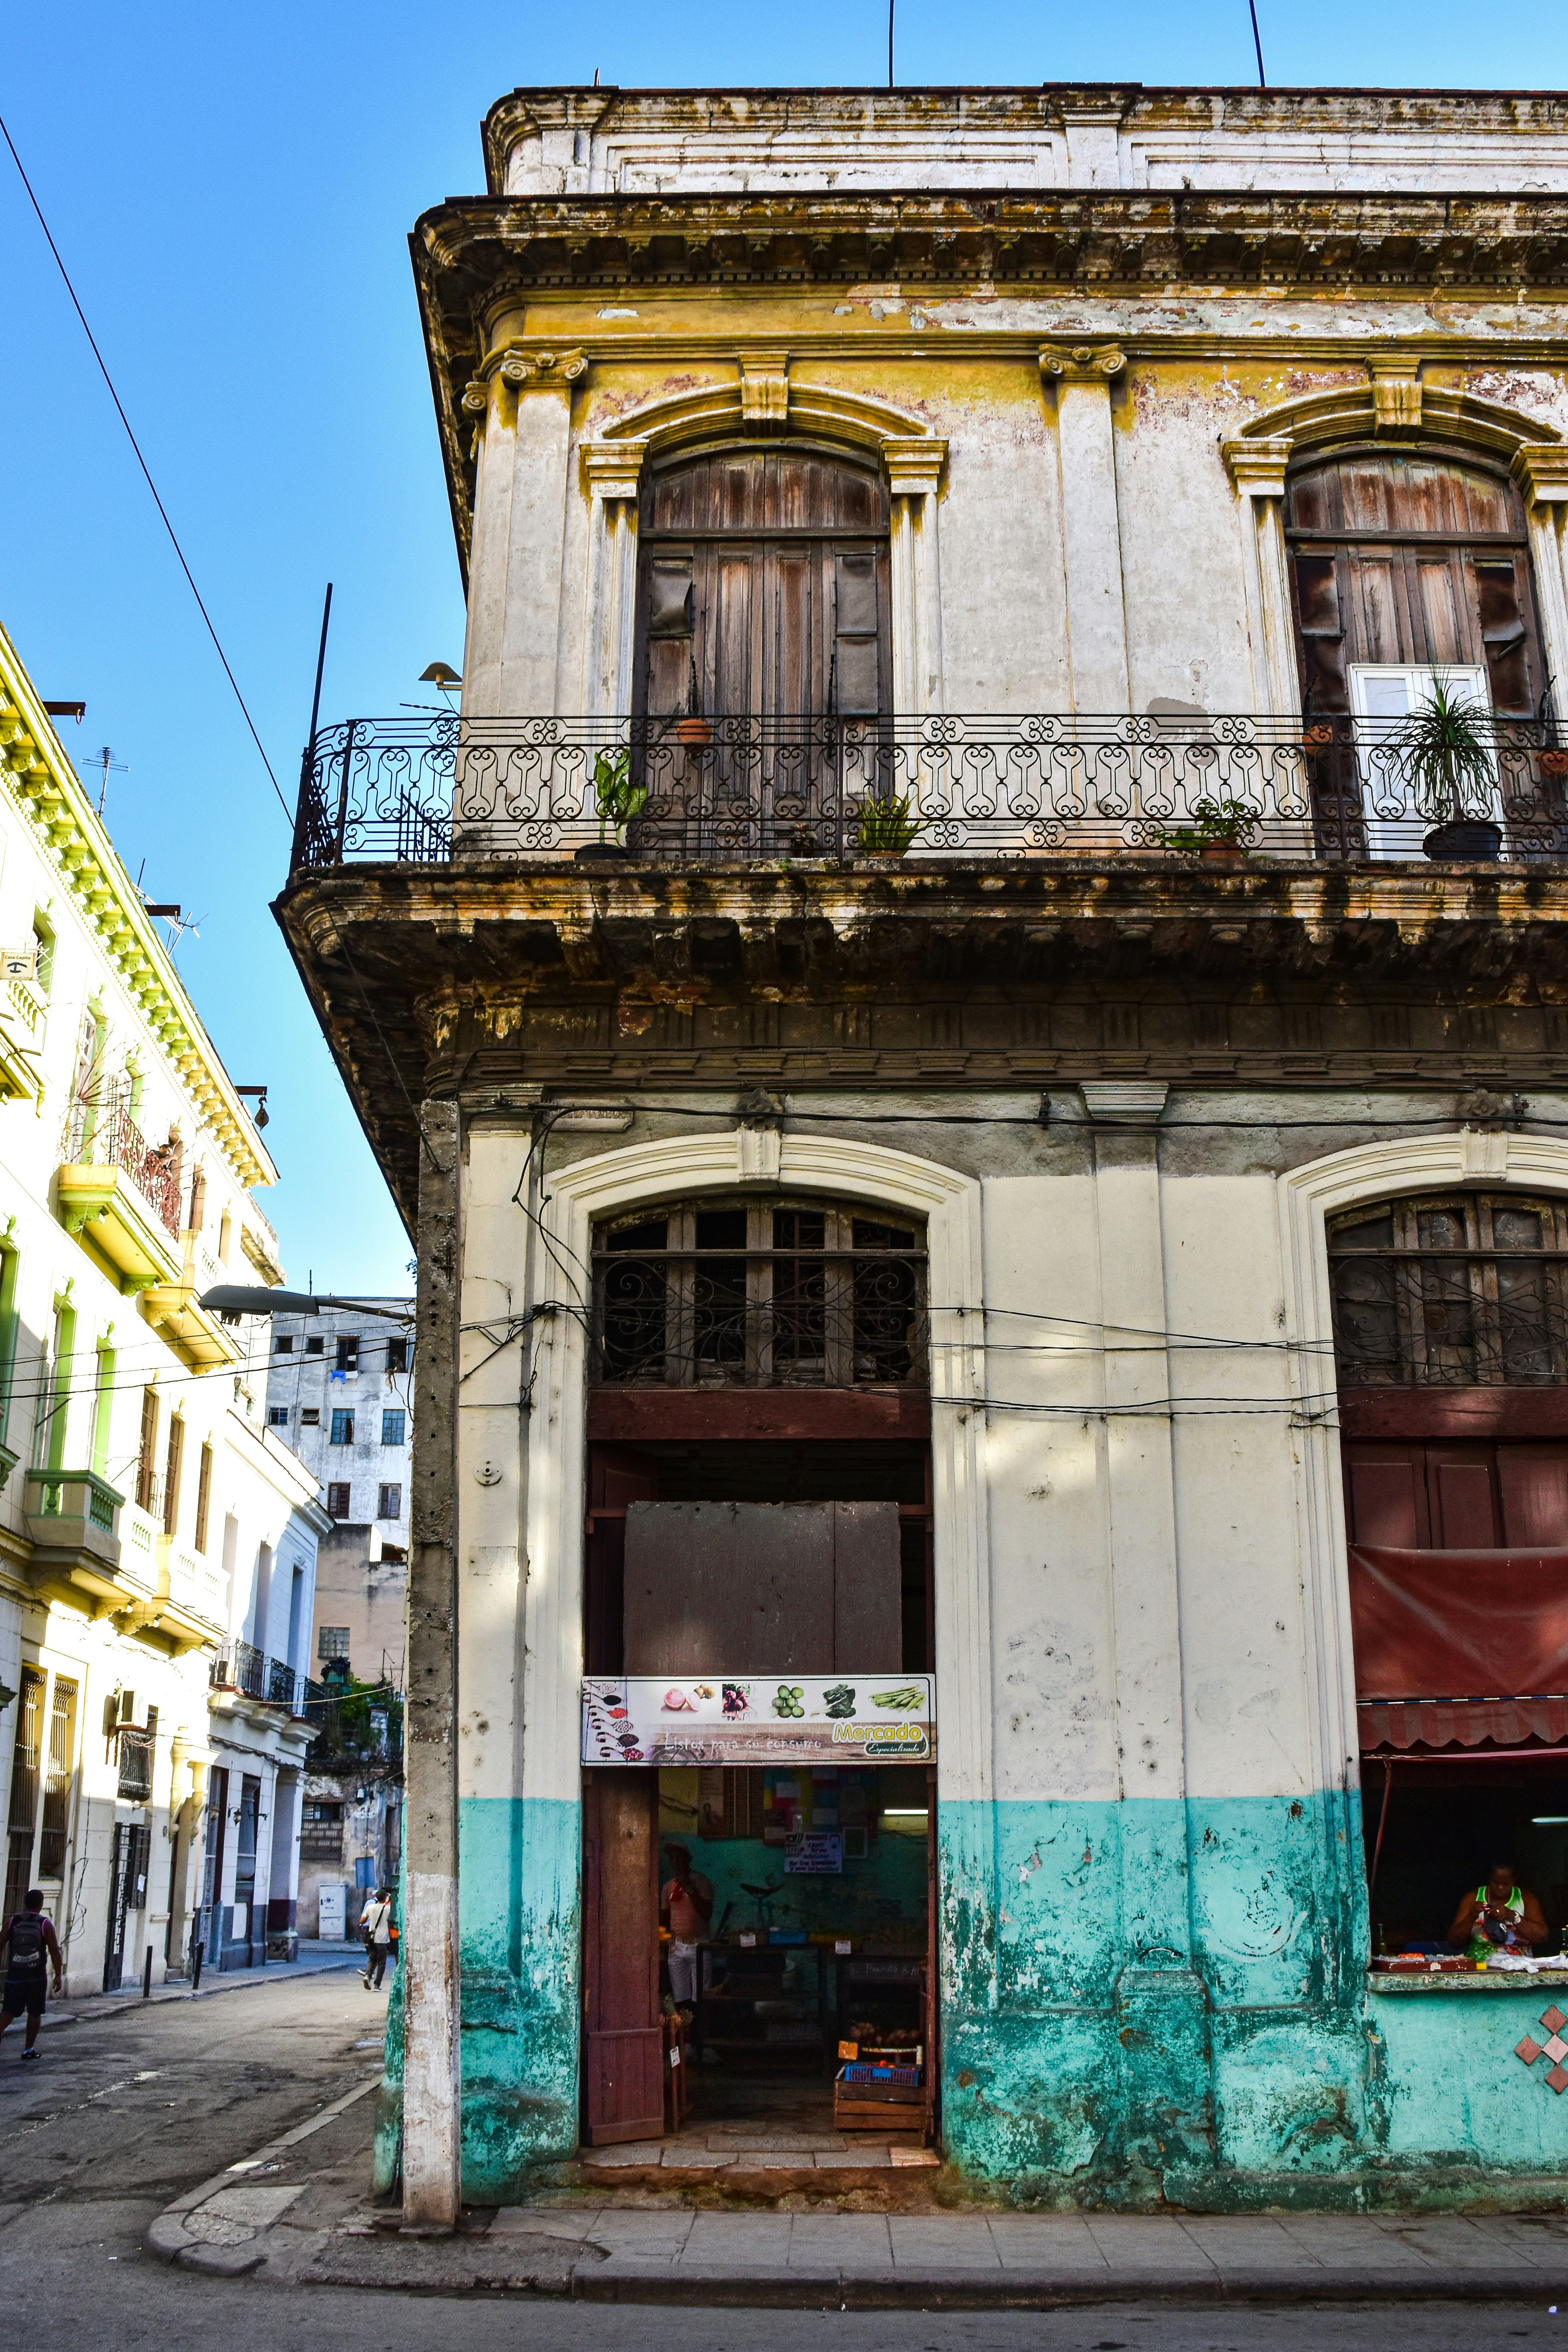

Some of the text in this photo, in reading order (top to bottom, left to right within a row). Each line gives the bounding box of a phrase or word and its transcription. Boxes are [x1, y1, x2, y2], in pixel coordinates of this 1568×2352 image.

[834, 1723, 921, 1740] Mercado
[665, 1731, 822, 1761] Listos para su consumo
[868, 1743, 919, 1754] Especializado
